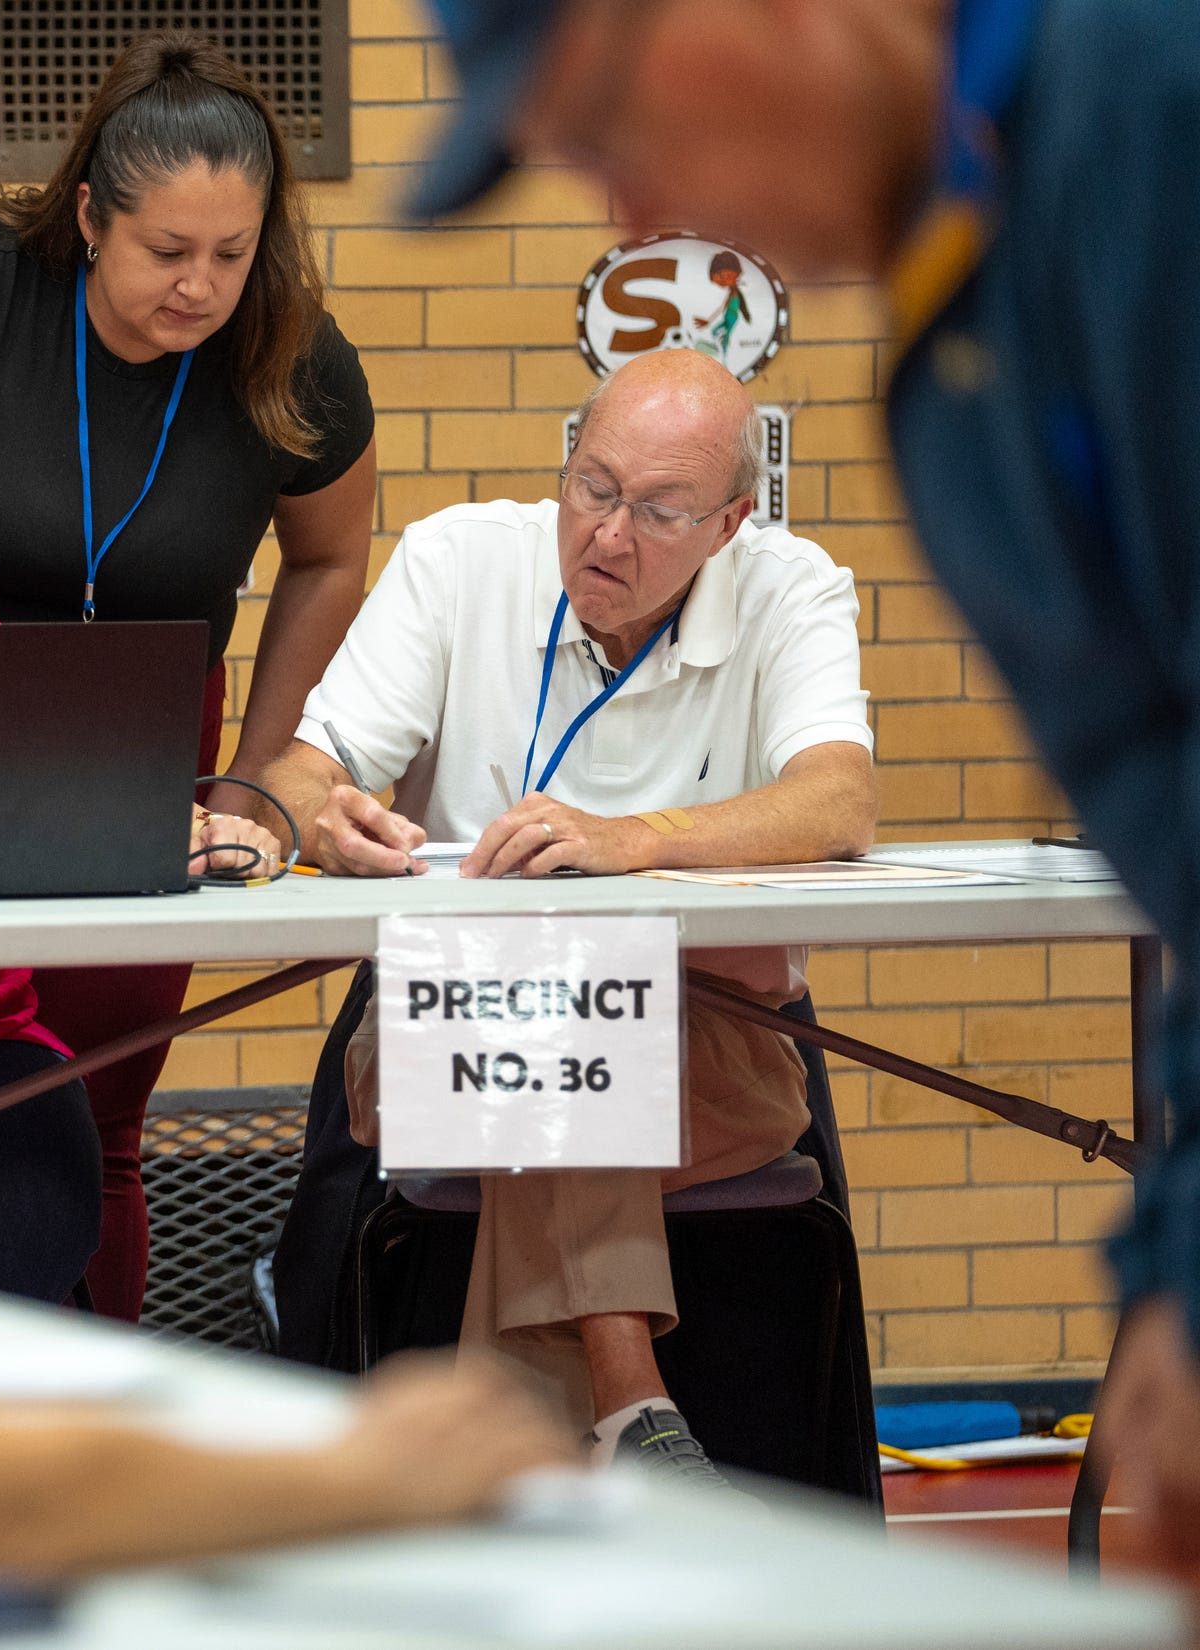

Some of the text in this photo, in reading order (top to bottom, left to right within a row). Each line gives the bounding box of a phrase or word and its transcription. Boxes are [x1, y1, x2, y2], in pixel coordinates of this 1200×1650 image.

[601, 257, 681, 353] S
[407, 979, 652, 1021] PRECINCT
[451, 1051, 612, 1093] NO. 36
